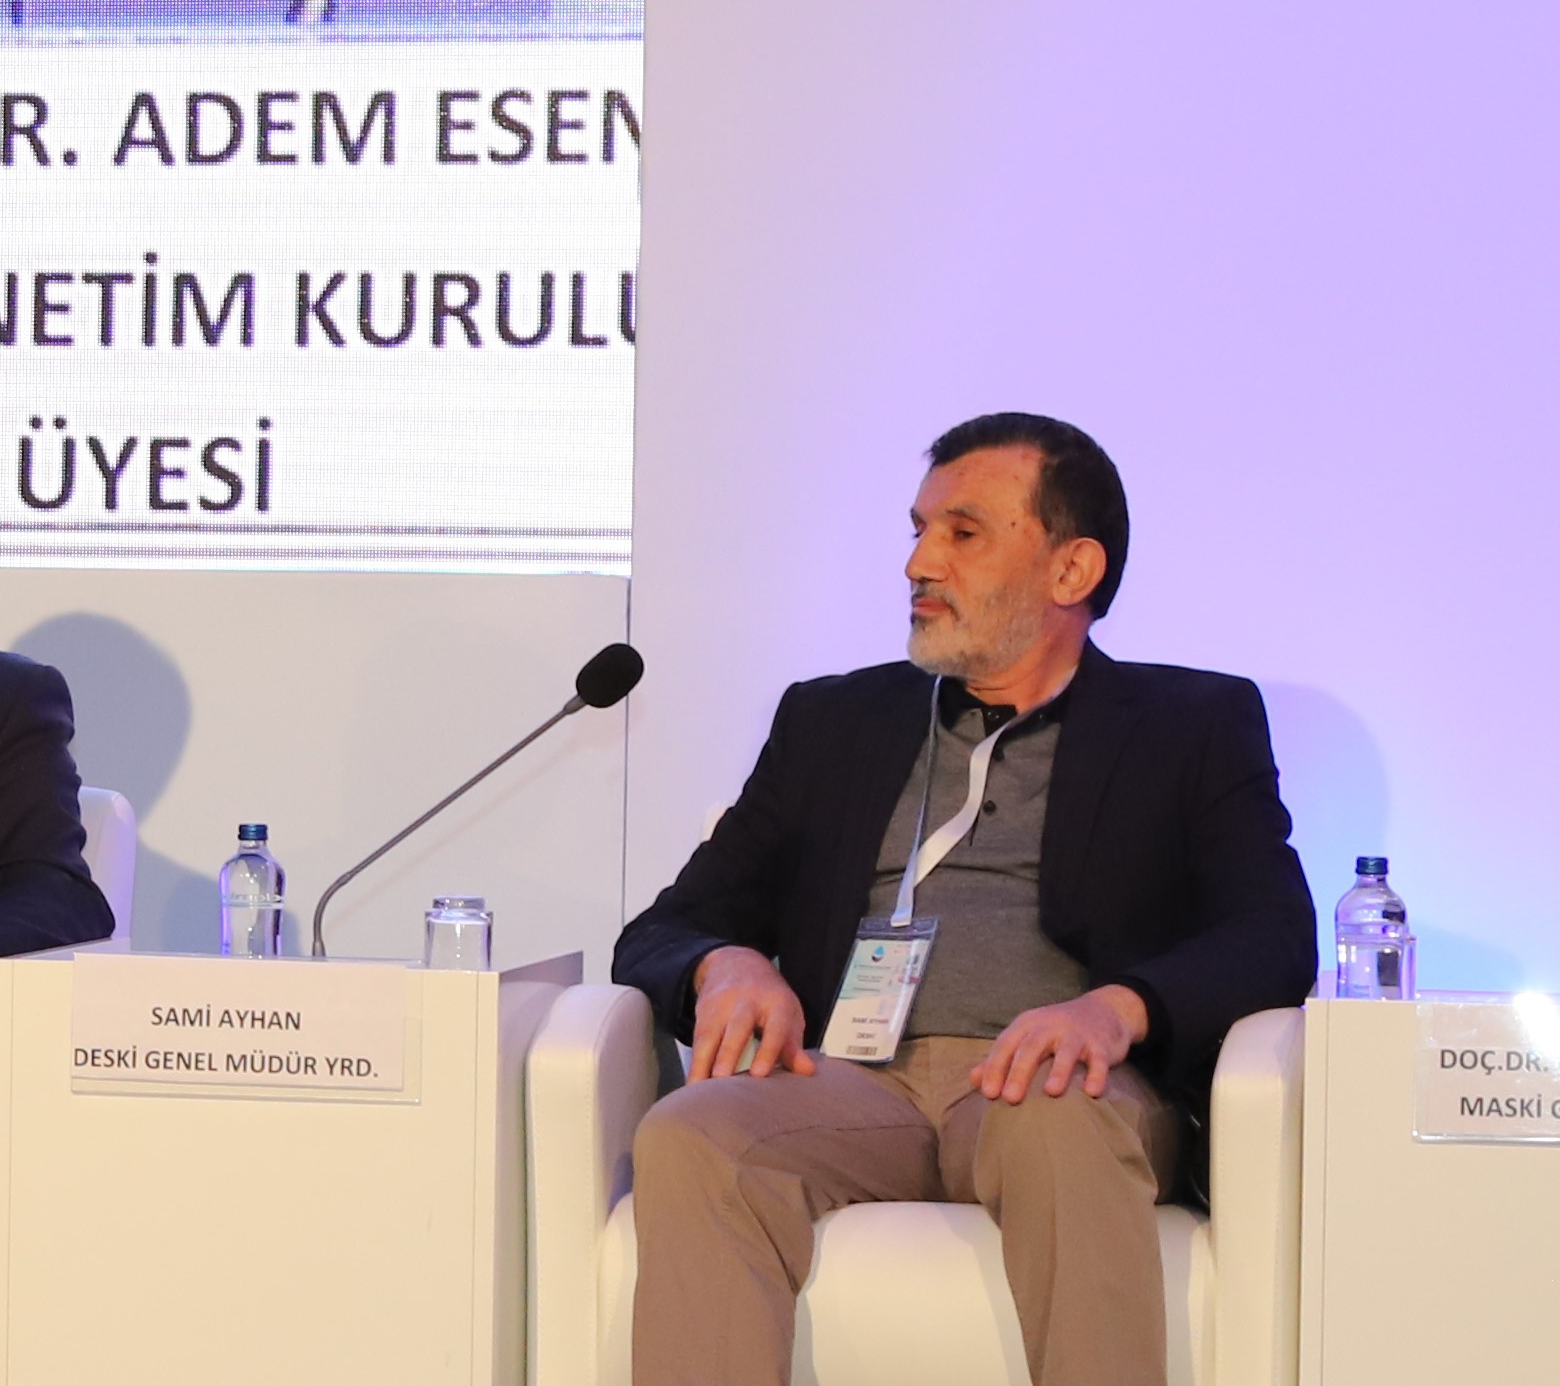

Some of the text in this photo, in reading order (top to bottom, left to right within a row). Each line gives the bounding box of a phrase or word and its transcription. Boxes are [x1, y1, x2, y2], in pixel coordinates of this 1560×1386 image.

[112, 90, 398, 167] ADEM
[16, 414, 276, 515] ÜYESİ
[150, 1004, 301, 1030] SAMİ AYHAN
[74, 1045, 379, 1078] DESKİ GENEL MÜDÜR YRD.
[1460, 1094, 1542, 1119] MASKİ
